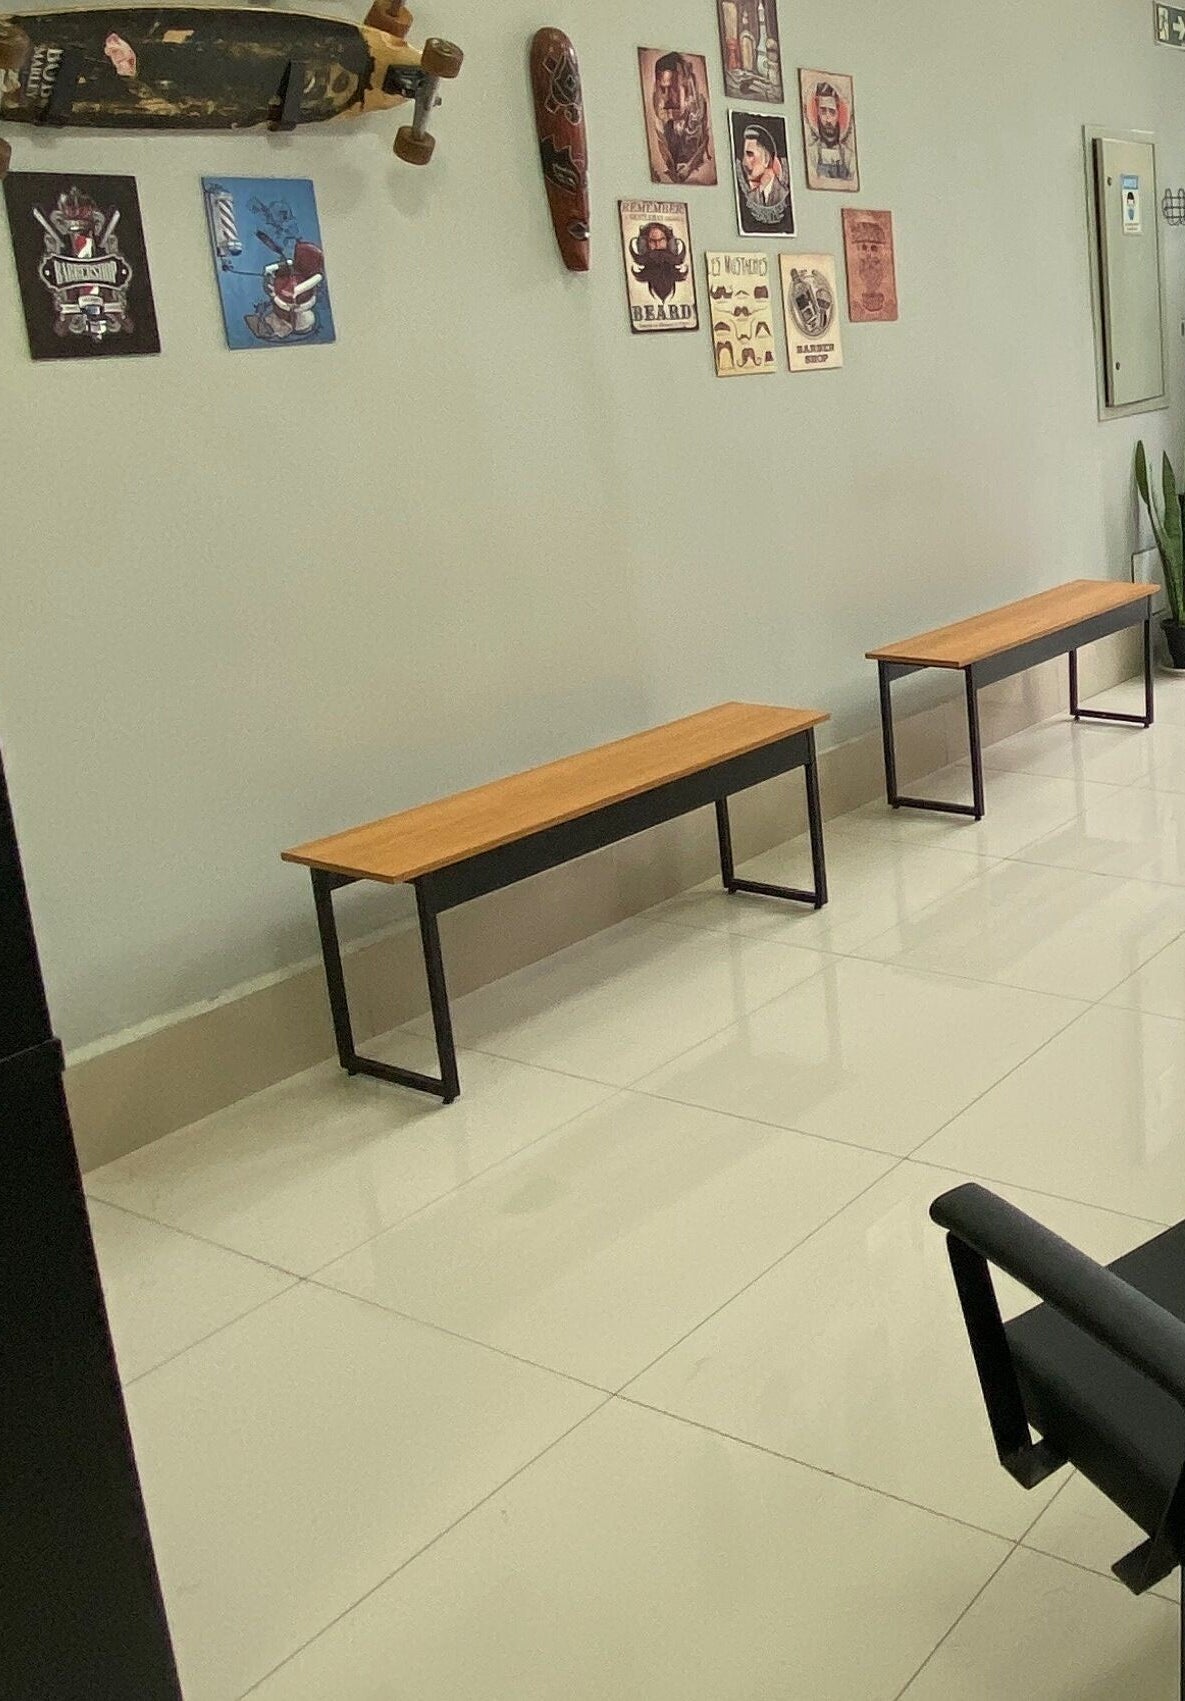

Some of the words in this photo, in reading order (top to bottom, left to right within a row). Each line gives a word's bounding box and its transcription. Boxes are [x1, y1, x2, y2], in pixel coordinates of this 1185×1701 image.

[632, 304, 691, 321] BEARD
[797, 343, 834, 354] BARBER
[805, 354, 828, 364] SHOP
